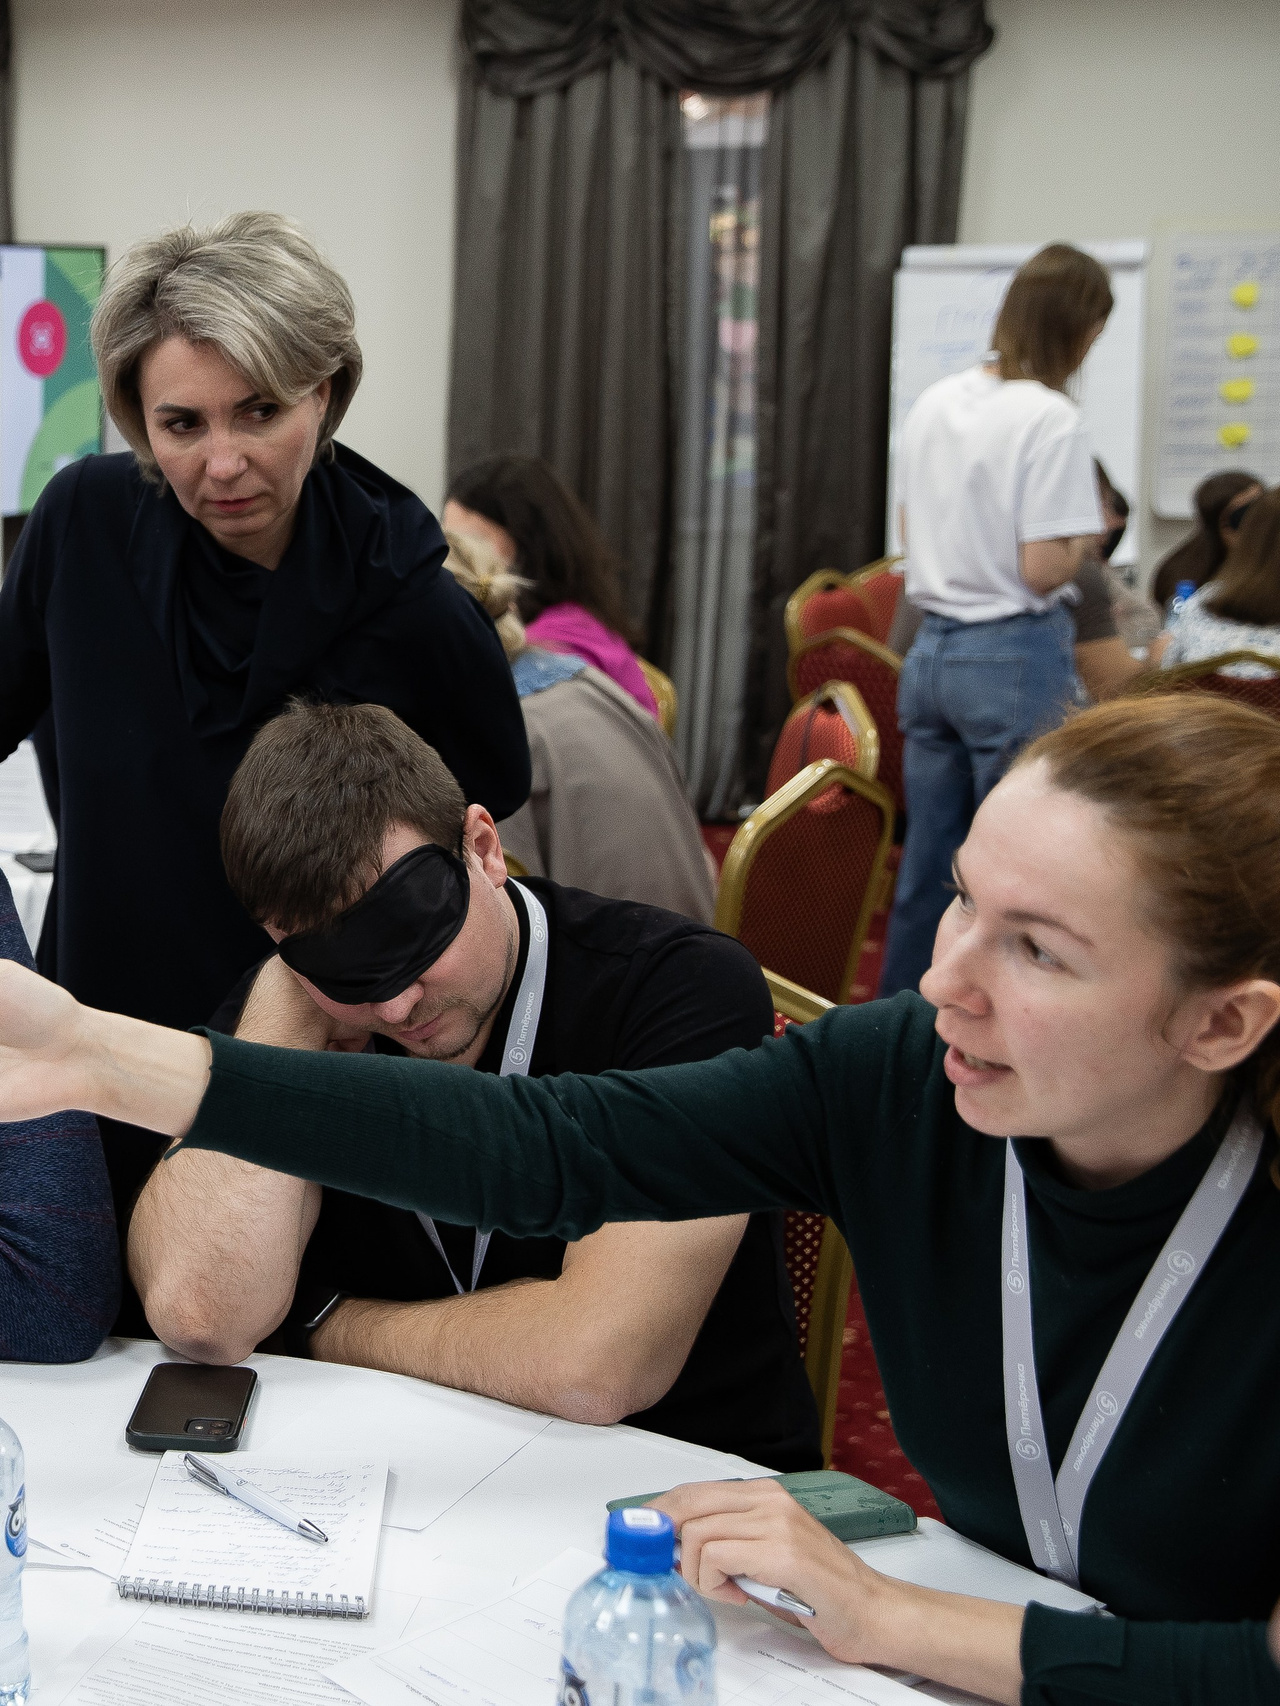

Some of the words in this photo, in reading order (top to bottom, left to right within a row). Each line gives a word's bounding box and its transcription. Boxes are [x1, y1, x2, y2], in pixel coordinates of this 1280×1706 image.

[517, 991, 535, 1047] Пятёрочка
[1010, 1193, 1019, 1268] Пятёрочка
[1134, 1273, 1177, 1340] Пятёрочка
[1015, 1363, 1032, 1436] Пятёрочка
[1073, 1409, 1105, 1472] Пятёрочка
